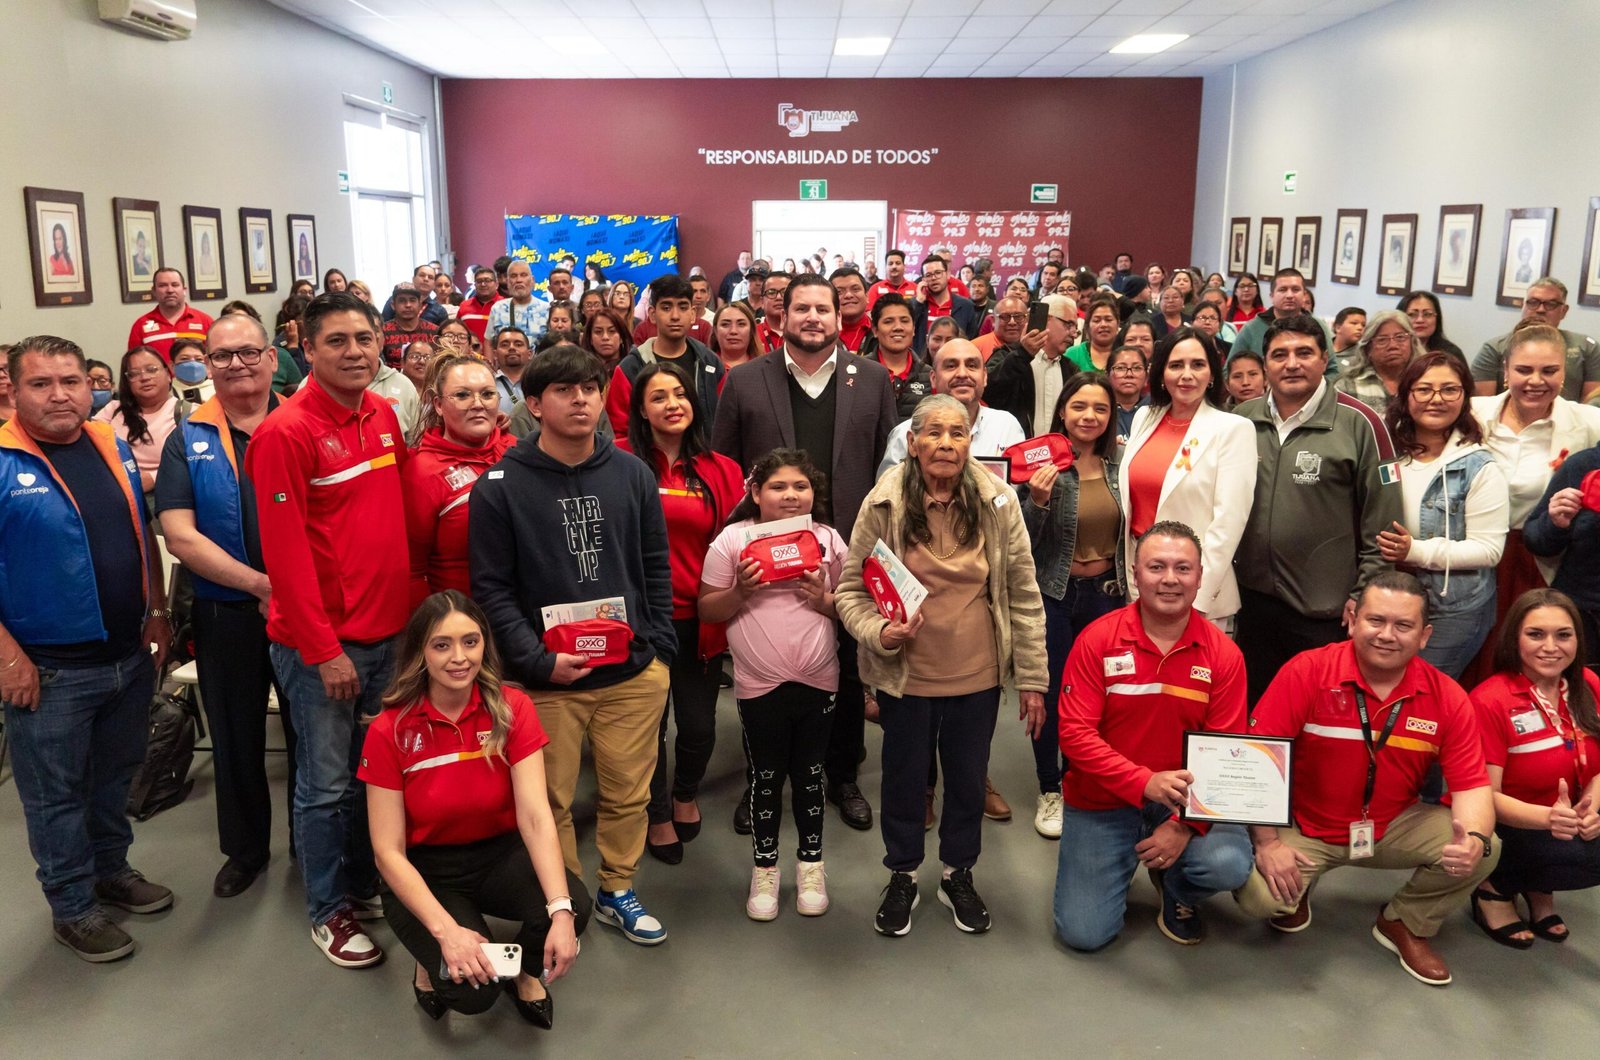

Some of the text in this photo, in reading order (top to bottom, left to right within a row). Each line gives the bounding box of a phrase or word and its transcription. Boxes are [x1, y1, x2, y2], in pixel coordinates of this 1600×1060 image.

[811, 112, 857, 121] TIJUANA
[852, 150, 871, 164] DE
[906, 211, 935, 226] globo
[941, 211, 970, 227] globo
[975, 211, 1004, 227] globo
[1009, 211, 1040, 227] globo
[1045, 211, 1071, 226] glob
[909, 227, 931, 236] 99.3
[944, 227, 966, 237] 99.3
[978, 227, 1000, 237] 99.3
[1013, 227, 1036, 237] 99.3
[963, 241, 992, 256] globo
[998, 240, 1027, 256] globo
[1001, 257, 1023, 267] 99.3
[1026, 448, 1049, 460] OXXO
[772, 545, 798, 559] OXXO
[577, 637, 605, 648] OXXO
[1190, 667, 1211, 681] OXX
[1407, 719, 1437, 734] OXXO
